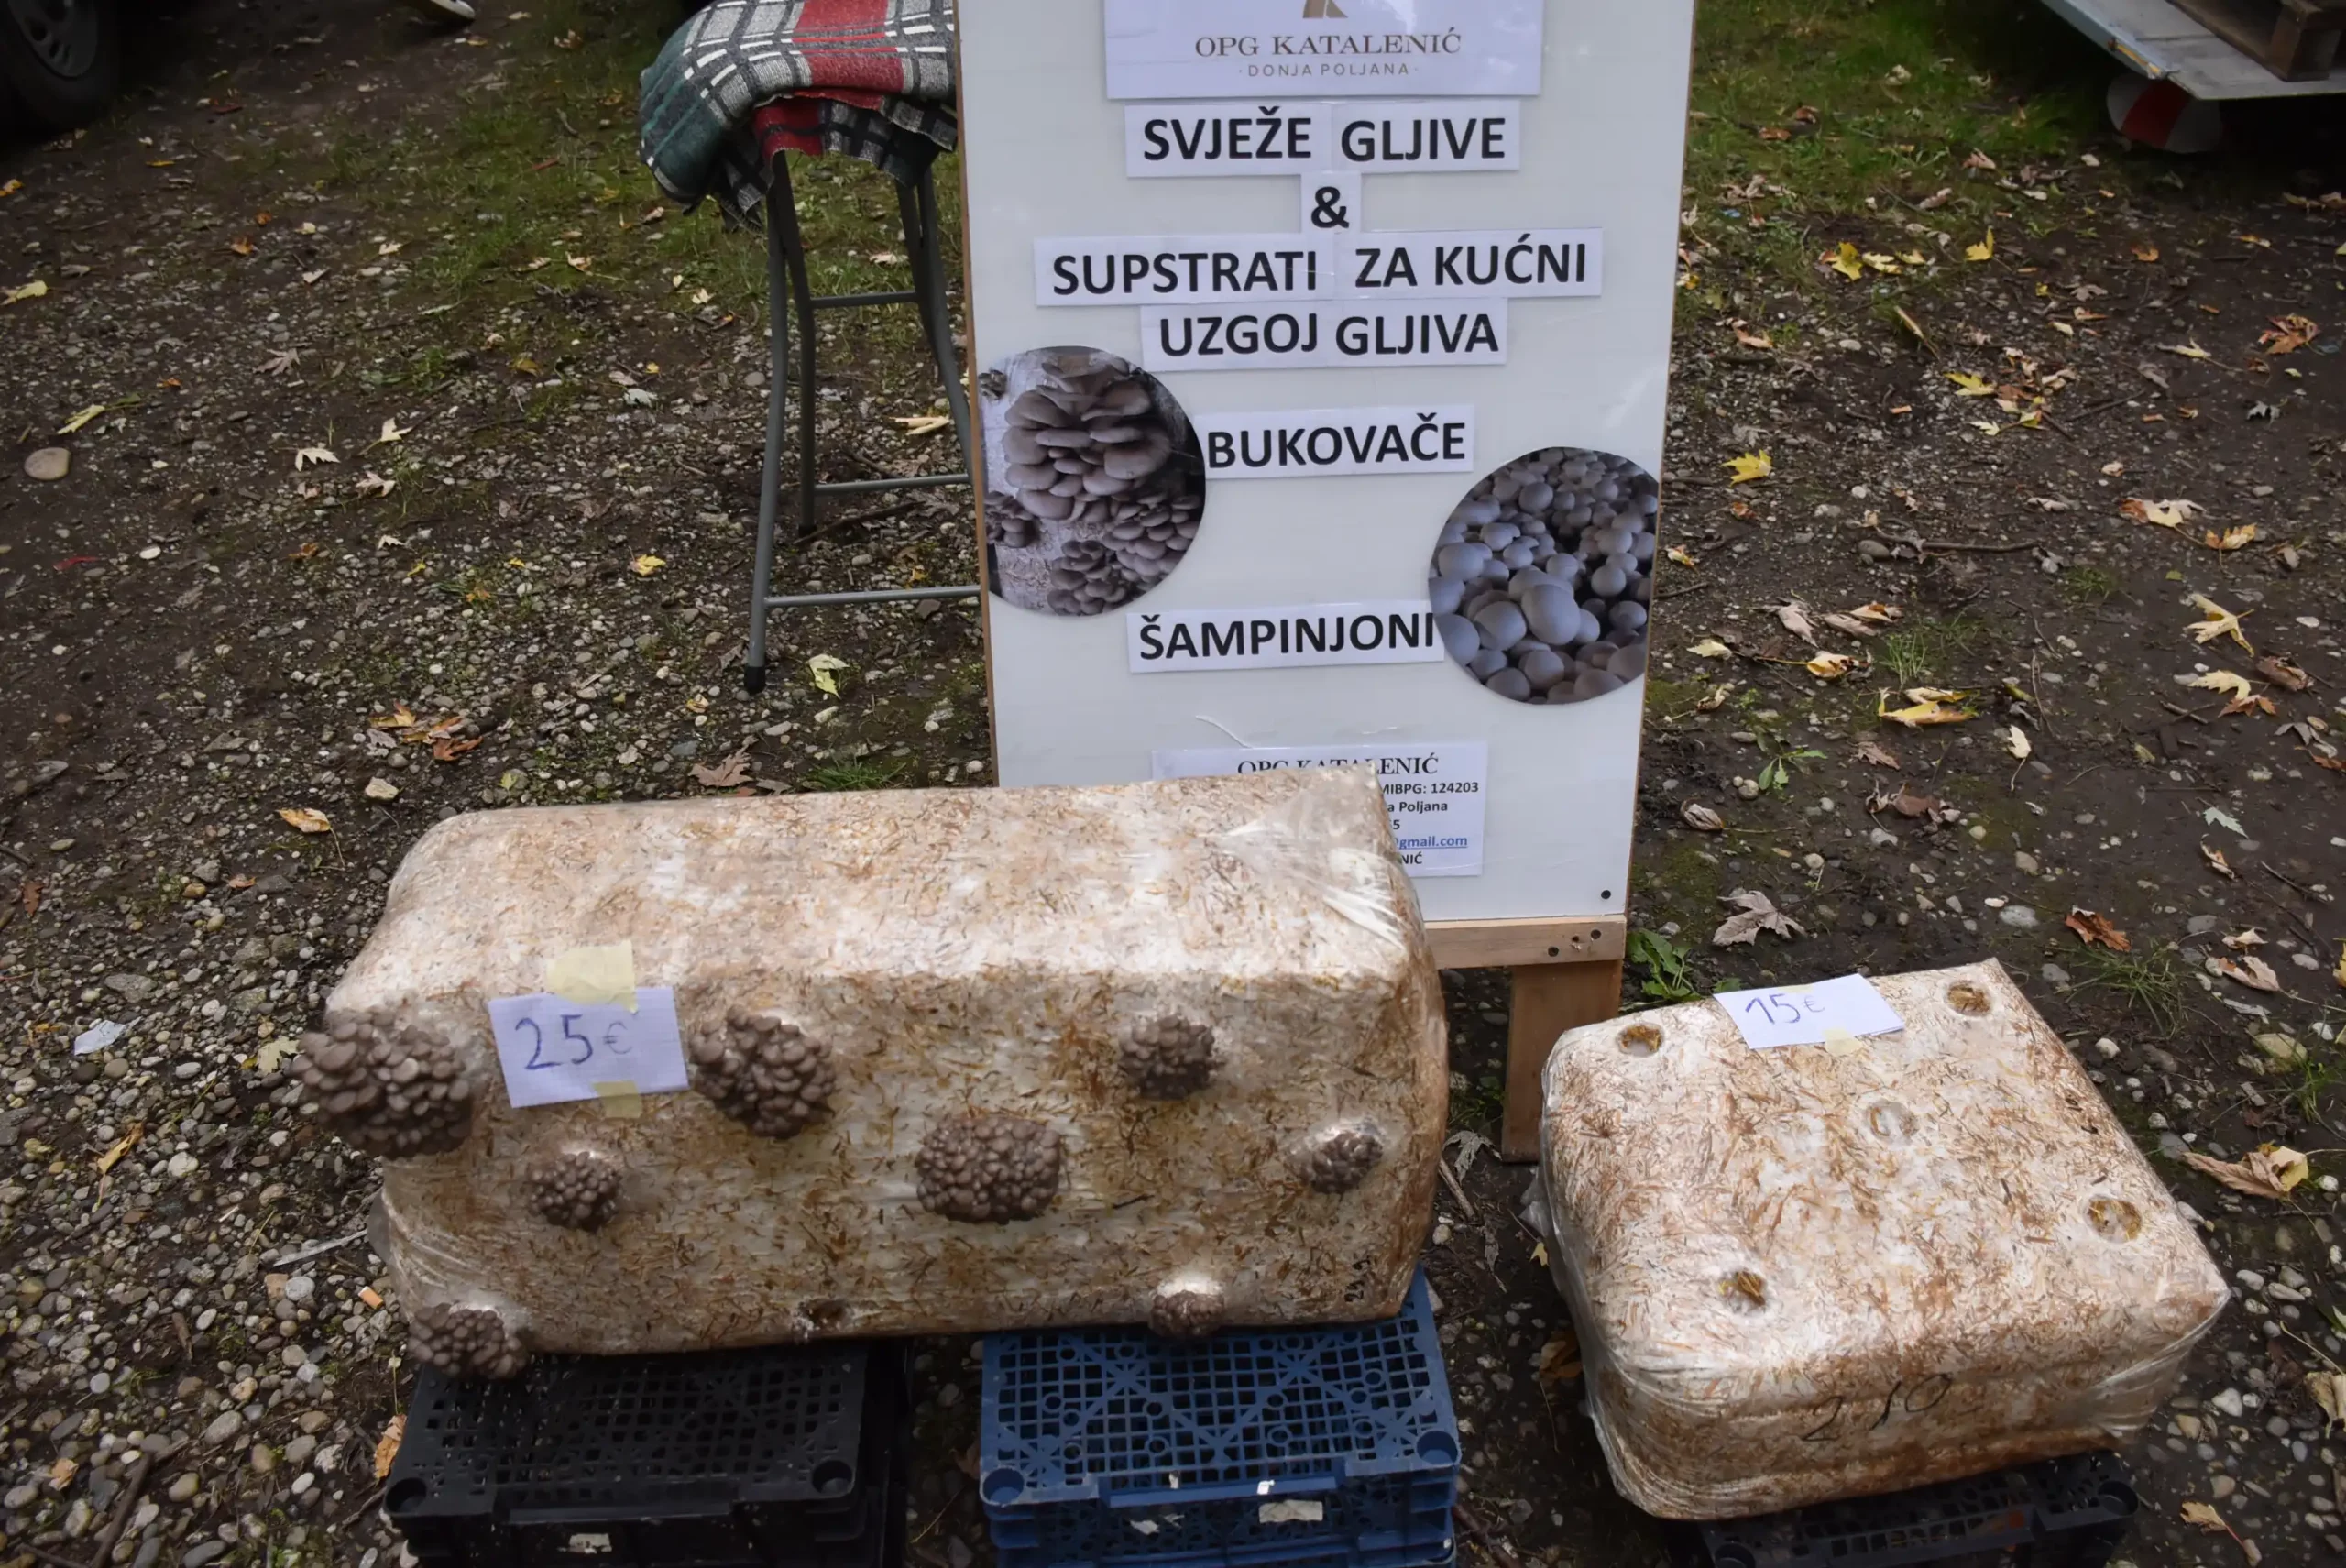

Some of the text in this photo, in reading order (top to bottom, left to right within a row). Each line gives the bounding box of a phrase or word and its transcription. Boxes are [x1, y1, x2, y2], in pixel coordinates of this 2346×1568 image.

[1195, 27, 1462, 57] OPG KATALENIĆ
[1248, 62, 1409, 77] DONJA POLJANA
[1144, 105, 1506, 162] SVJEŽE GLJIVE
[1310, 185, 1350, 229] &
[1053, 234, 1586, 296] SUPSTRATI ZA KUĆNI
[1160, 313, 1499, 357] UZGOJ GLJIVA
[1207, 412, 1465, 469] BUKOVAČE
[1139, 612, 1434, 661] ŠAMPINJONI
[1398, 800, 1448, 815] Poljana
[1431, 781, 1479, 795] 124203
